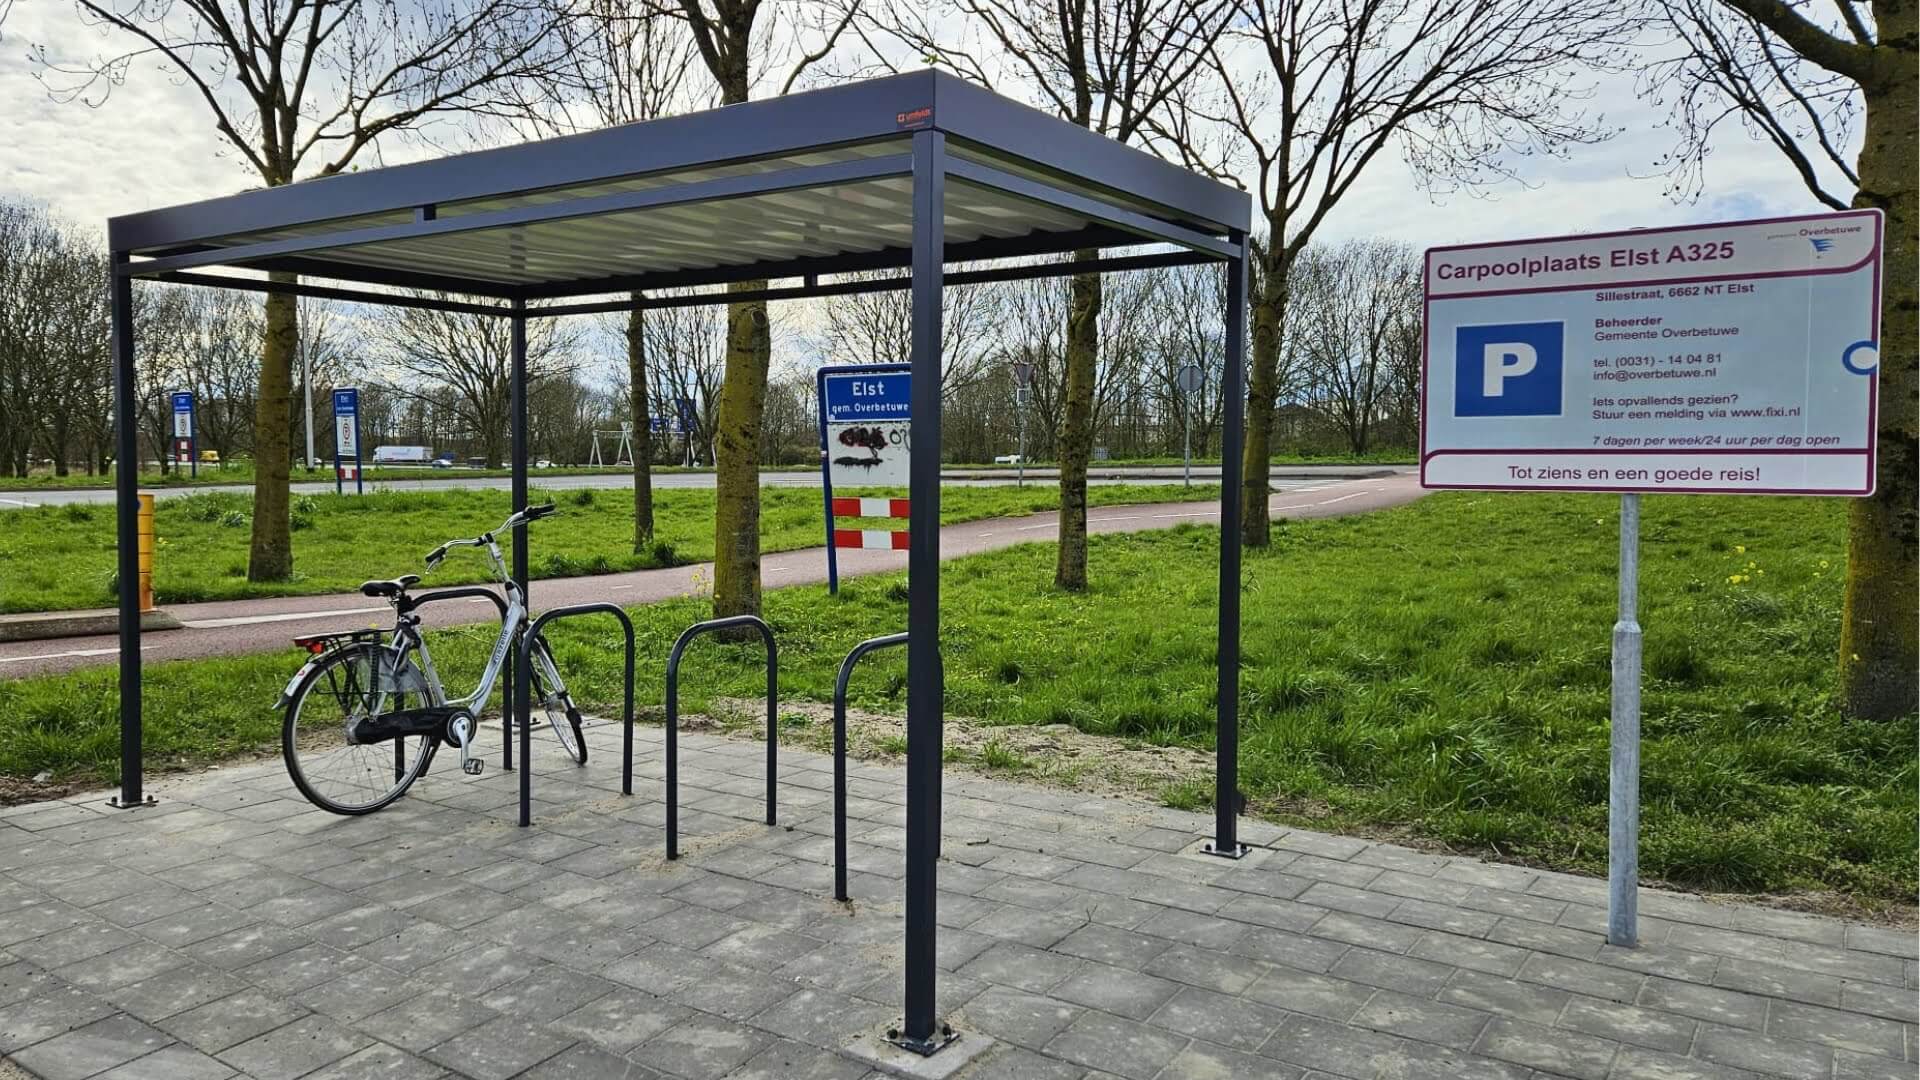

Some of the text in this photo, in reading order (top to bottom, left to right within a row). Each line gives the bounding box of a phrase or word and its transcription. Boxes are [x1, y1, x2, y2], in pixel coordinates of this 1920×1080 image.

[1798, 225, 1862, 237] Overbetuwe
[1437, 241, 1735, 281] Carpoolplaats Elst A325
[1595, 284, 1754, 302] Sillestraat, 6662 NT Elst
[1595, 316, 1663, 328] Beheerder
[1594, 326, 1740, 341] Gemeente Overbetuwe
[1594, 358, 1611, 368] tel.
[1615, 355, 1656, 367] (0031)
[1668, 355, 1682, 364] 14
[1686, 354, 1702, 364] 04
[1706, 353, 1722, 363] 81
[1482, 342, 1538, 397] P
[1593, 368, 1717, 382] info@overbetuwe.nl
[852, 381, 885, 396] Elst
[1592, 394, 1739, 407] Iets opvallends gezien?
[832, 402, 909, 415] gem. Overbetuwe
[1592, 406, 1801, 420] Stuur een melding via www.fixi.nl
[1592, 434, 1841, 448] 7 dagen per week/24 uur per dag open
[1508, 465, 1761, 483] Tot ziens en een goede reis!
